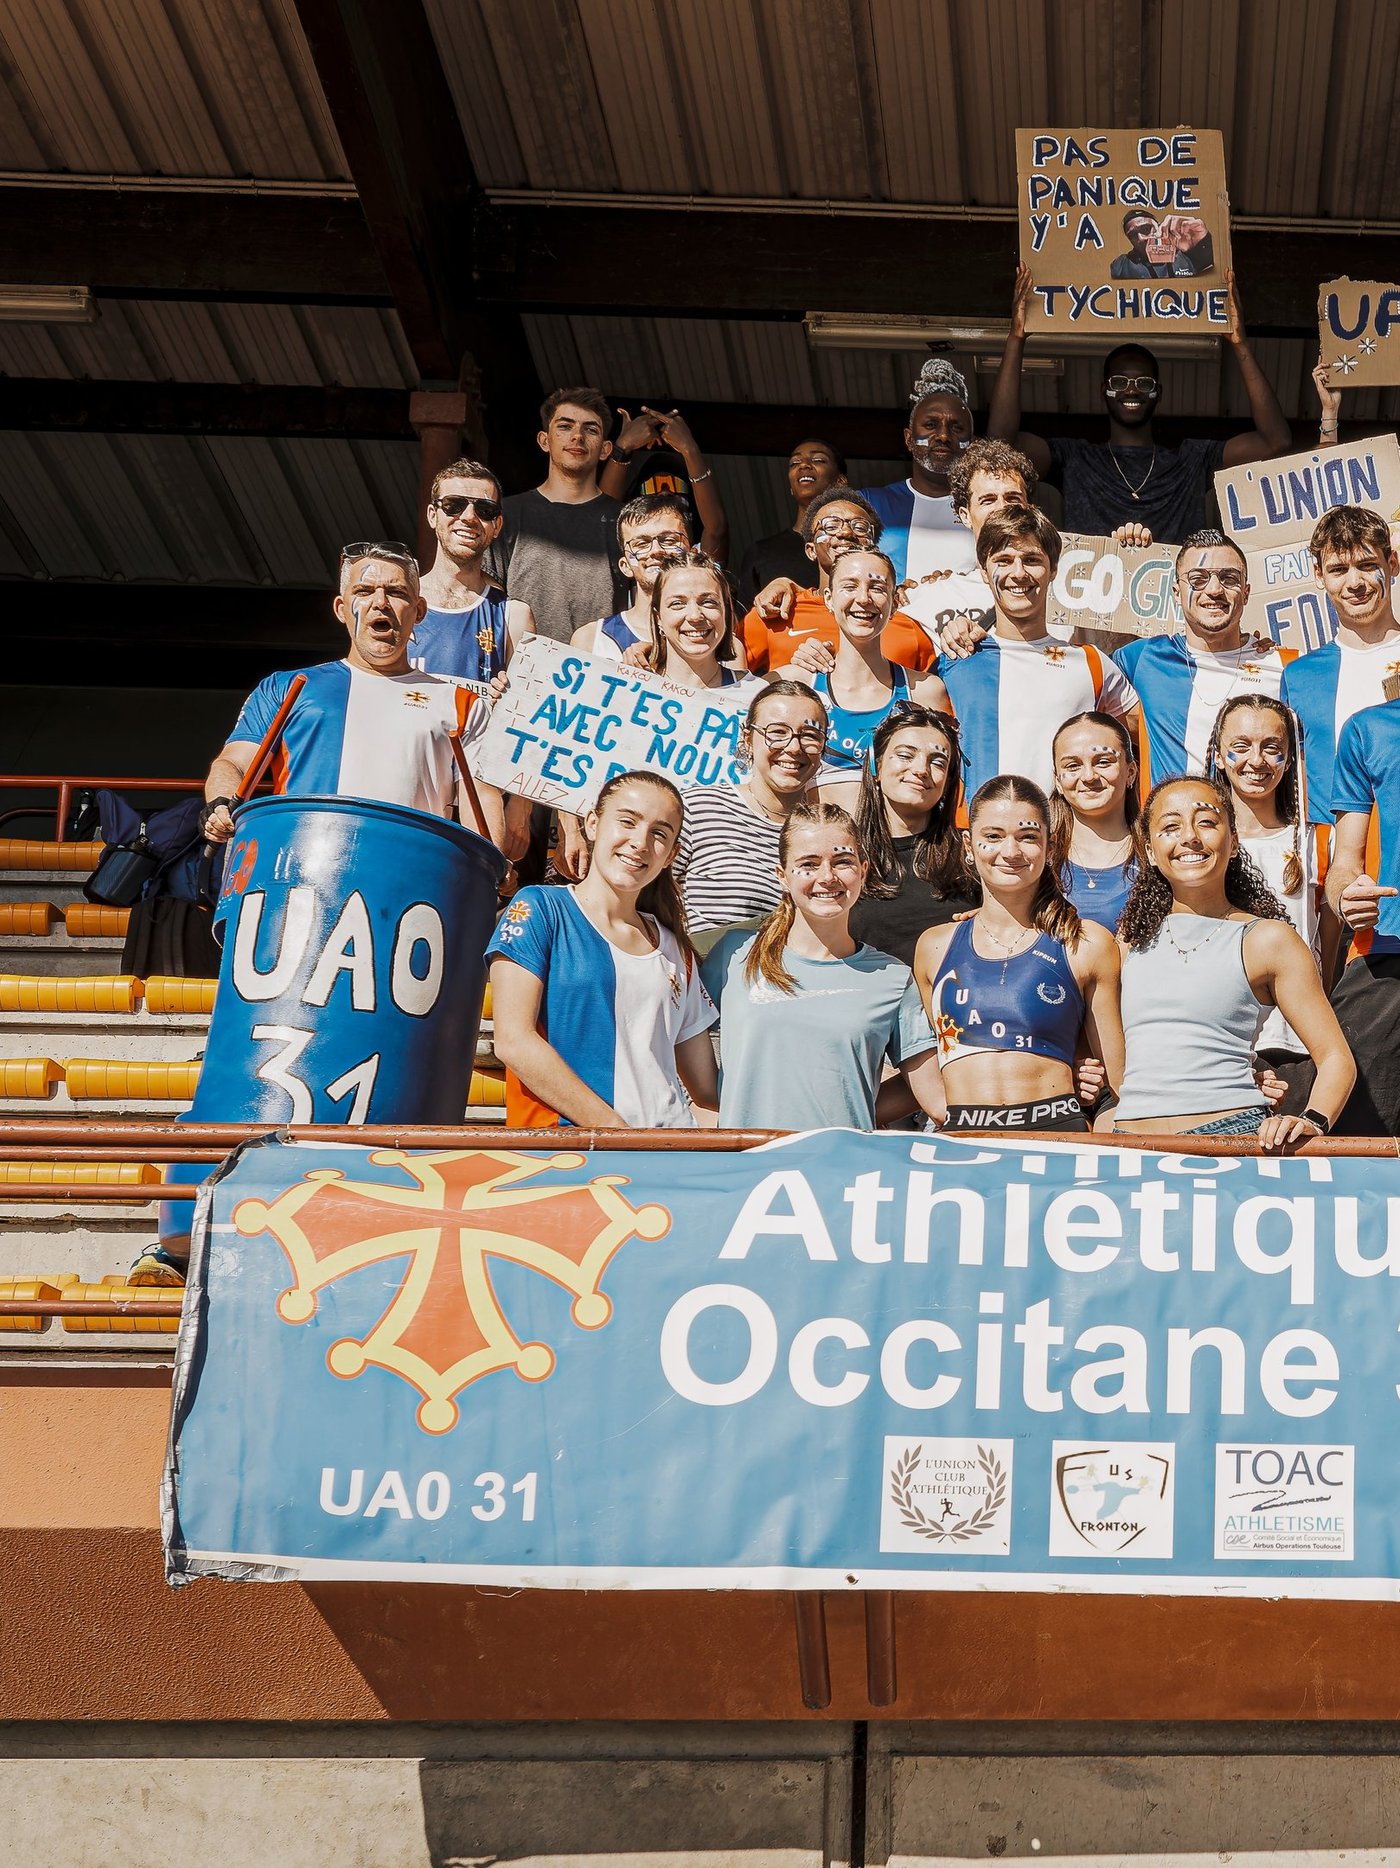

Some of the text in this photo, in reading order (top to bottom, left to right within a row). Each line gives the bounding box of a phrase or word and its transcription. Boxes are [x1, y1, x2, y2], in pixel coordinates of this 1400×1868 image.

[1033, 134, 1198, 167] PAS DE
[1028, 174, 1201, 210] PANIQUE
[1029, 212, 1105, 252] Y'A
[1033, 284, 1229, 323] TYCHIQUE
[1226, 452, 1382, 533] L'UNION
[1052, 549, 1124, 614] GO
[529, 694, 623, 752] AVEC
[601, 673, 684, 736] T'ES
[694, 707, 749, 756] PA
[505, 726, 594, 789] T'ES
[645, 734, 749, 786] NOUS
[504, 772, 569, 808] ALLEZ
[233, 886, 446, 1018] UAO
[1032, 949, 1058, 966] KIPRUN
[250, 1025, 380, 1125] 31
[957, 1108, 1027, 1128] NIKE
[1031, 1097, 1082, 1123] PRO
[660, 1284, 1339, 1417] Occitane
[925, 1459, 976, 1469] L'UNION
[934, 1472, 966, 1482] CLUB
[1225, 1449, 1345, 1487] TOAC
[471, 1471, 538, 1522] 31
[910, 1483, 989, 1497] ATHLÉTIQUE
[1081, 1521, 1139, 1532] FRONTON
[1224, 1515, 1345, 1532] ATHLETISME
[1275, 1542, 1311, 1551] Operations
